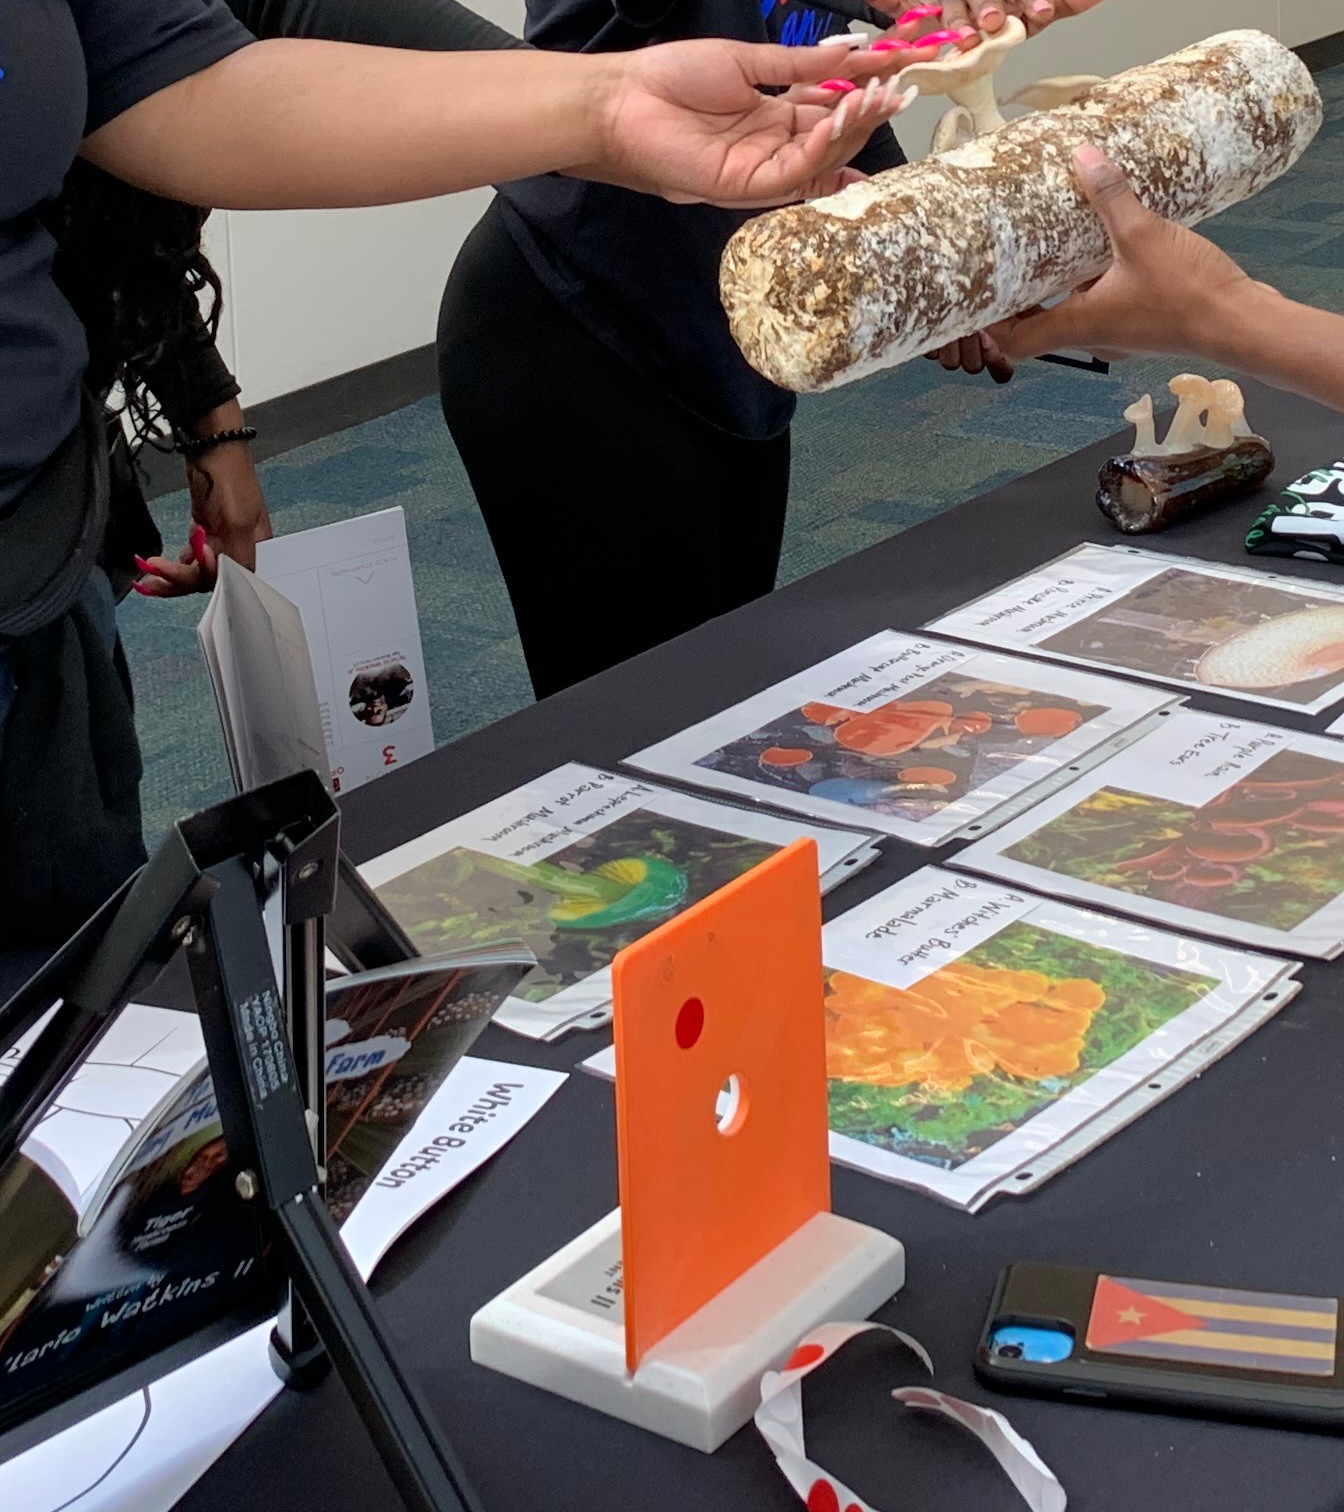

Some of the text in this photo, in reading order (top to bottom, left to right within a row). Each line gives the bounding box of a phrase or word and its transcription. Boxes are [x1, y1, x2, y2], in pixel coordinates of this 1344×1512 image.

[1194, 732, 1229, 748] Tree
[382, 744, 398, 766] 3
[1169, 750, 1199, 765] Ears
[555, 782, 604, 806] Parrot
[865, 887, 959, 938] Marmalade
[897, 938, 951, 965] Butter
[240, 1001, 267, 1099] Made in China
[274, 1040, 288, 1083] China
[326, 1049, 386, 1074] Farm
[376, 1083, 524, 1188] White Button
[101, 1271, 219, 1328] Watkins
